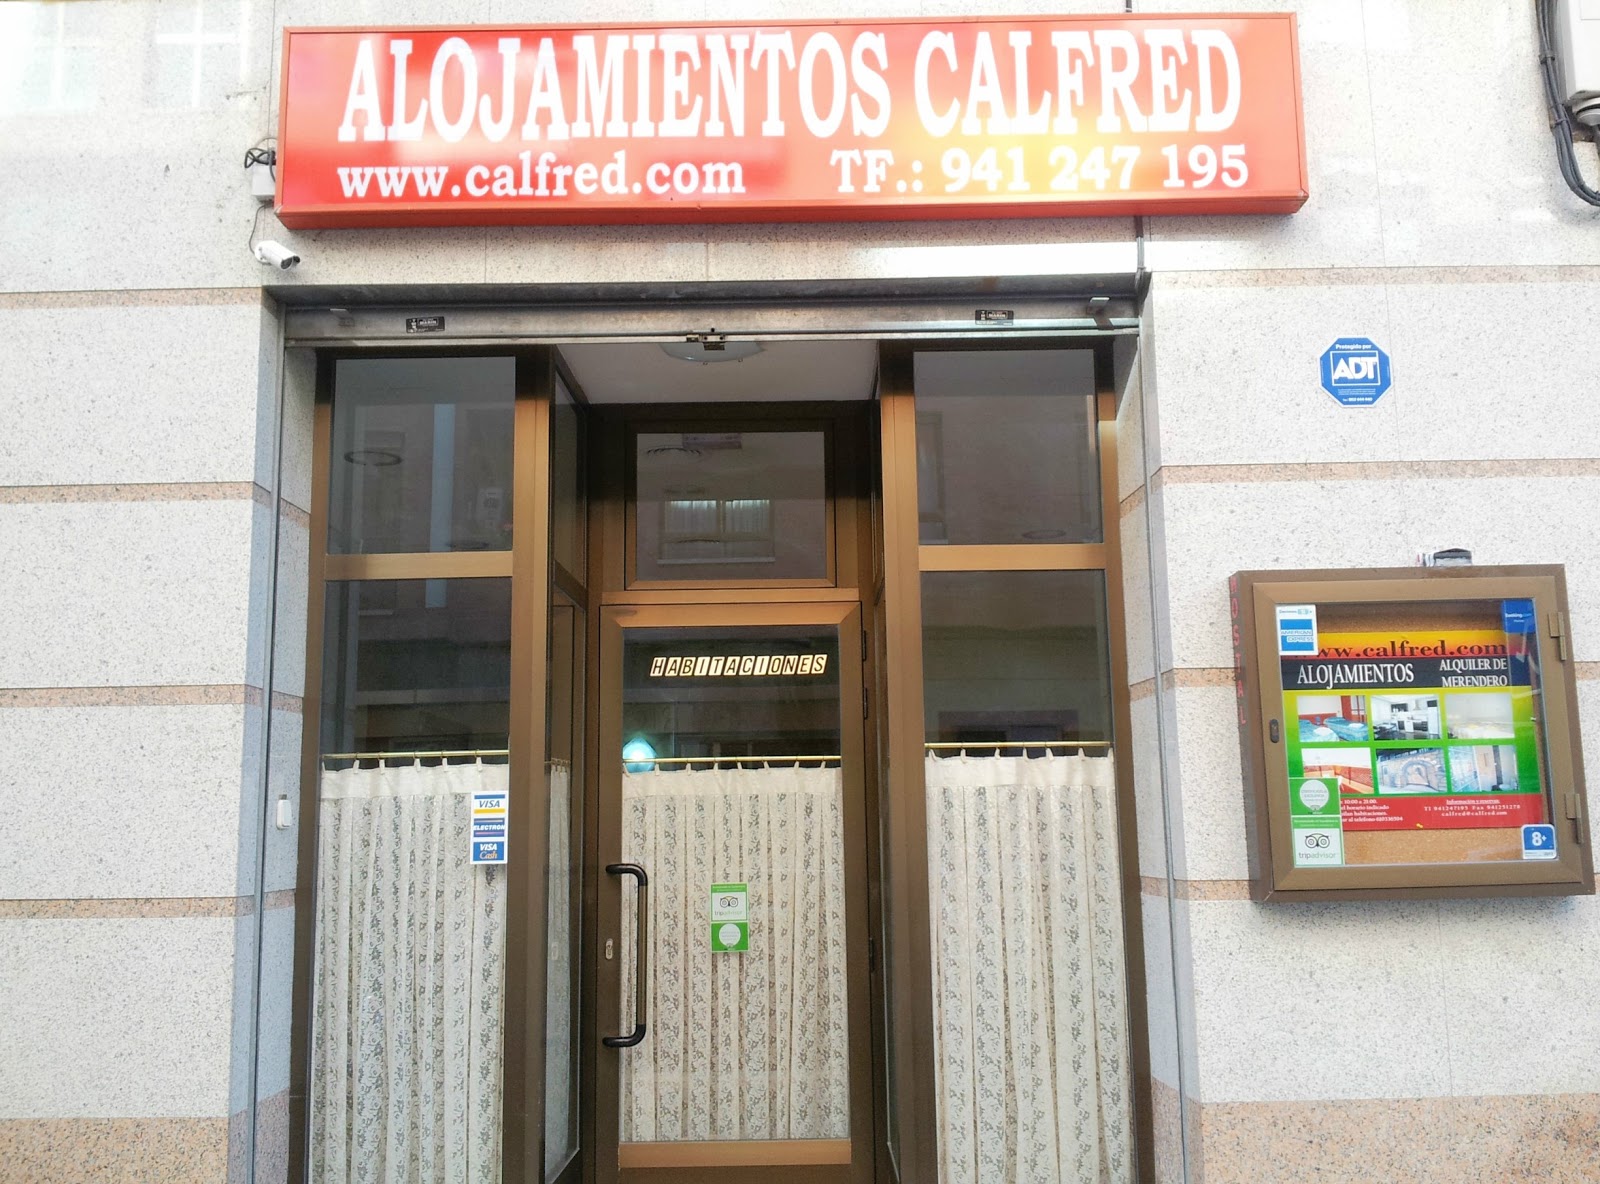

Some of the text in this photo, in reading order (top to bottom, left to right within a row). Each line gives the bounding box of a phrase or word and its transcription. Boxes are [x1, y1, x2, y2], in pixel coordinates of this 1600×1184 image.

[337, 28, 1242, 142] ALOJAMIENTOS CALFRED
[336, 143, 1250, 198] www.calfred.com TF.: 941 247 195
[1333, 356, 1378, 380] ADT
[1229, 576, 1247, 725] HOSTAL
[1316, 639, 1507, 658] ww.calfred.com
[650, 655, 827, 676] HABITACIONES
[1439, 658, 1508, 673] ALQUILER DE
[1297, 662, 1415, 690] ALOJAMIENTOS
[1441, 674, 1508, 688] MERENDERO
[479, 800, 500, 808] VISA
[479, 843, 498, 851] VISA
[479, 851, 498, 860] Cash
